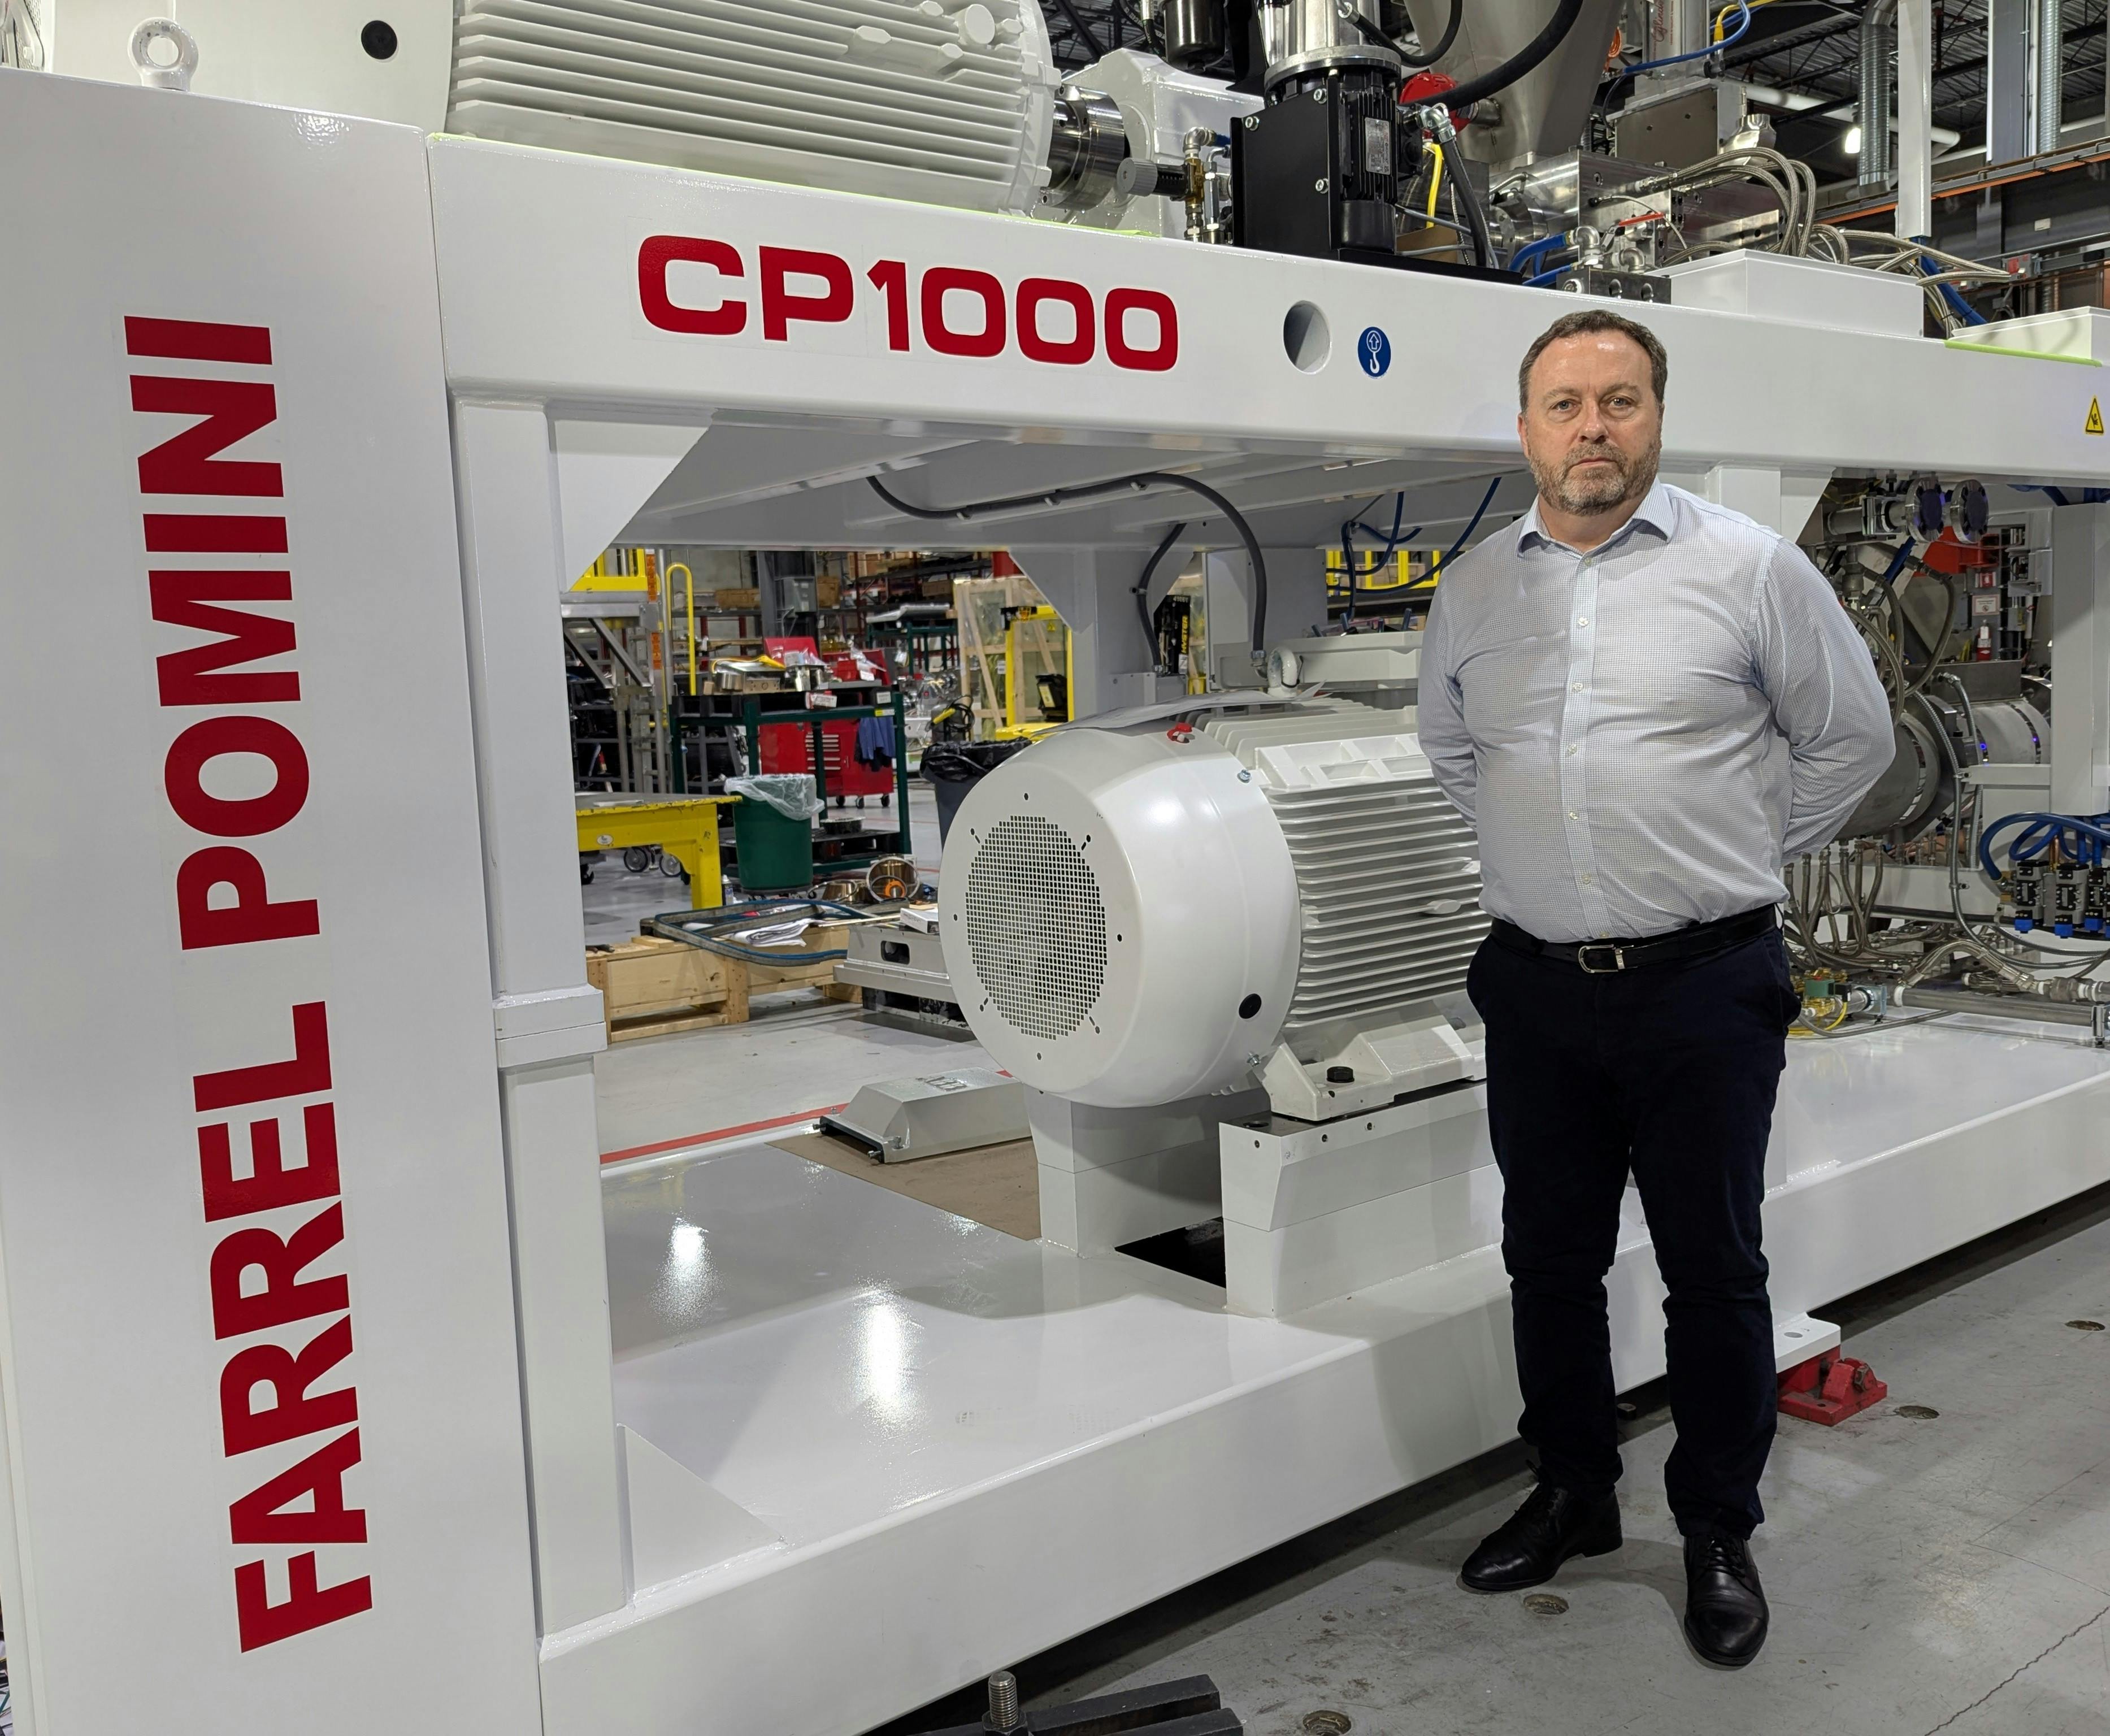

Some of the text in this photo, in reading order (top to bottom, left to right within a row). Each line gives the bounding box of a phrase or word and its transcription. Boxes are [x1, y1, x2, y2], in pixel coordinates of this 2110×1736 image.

[638, 235, 1178, 371] CP1000
[125, 317, 372, 1651] FARREL POMINI
